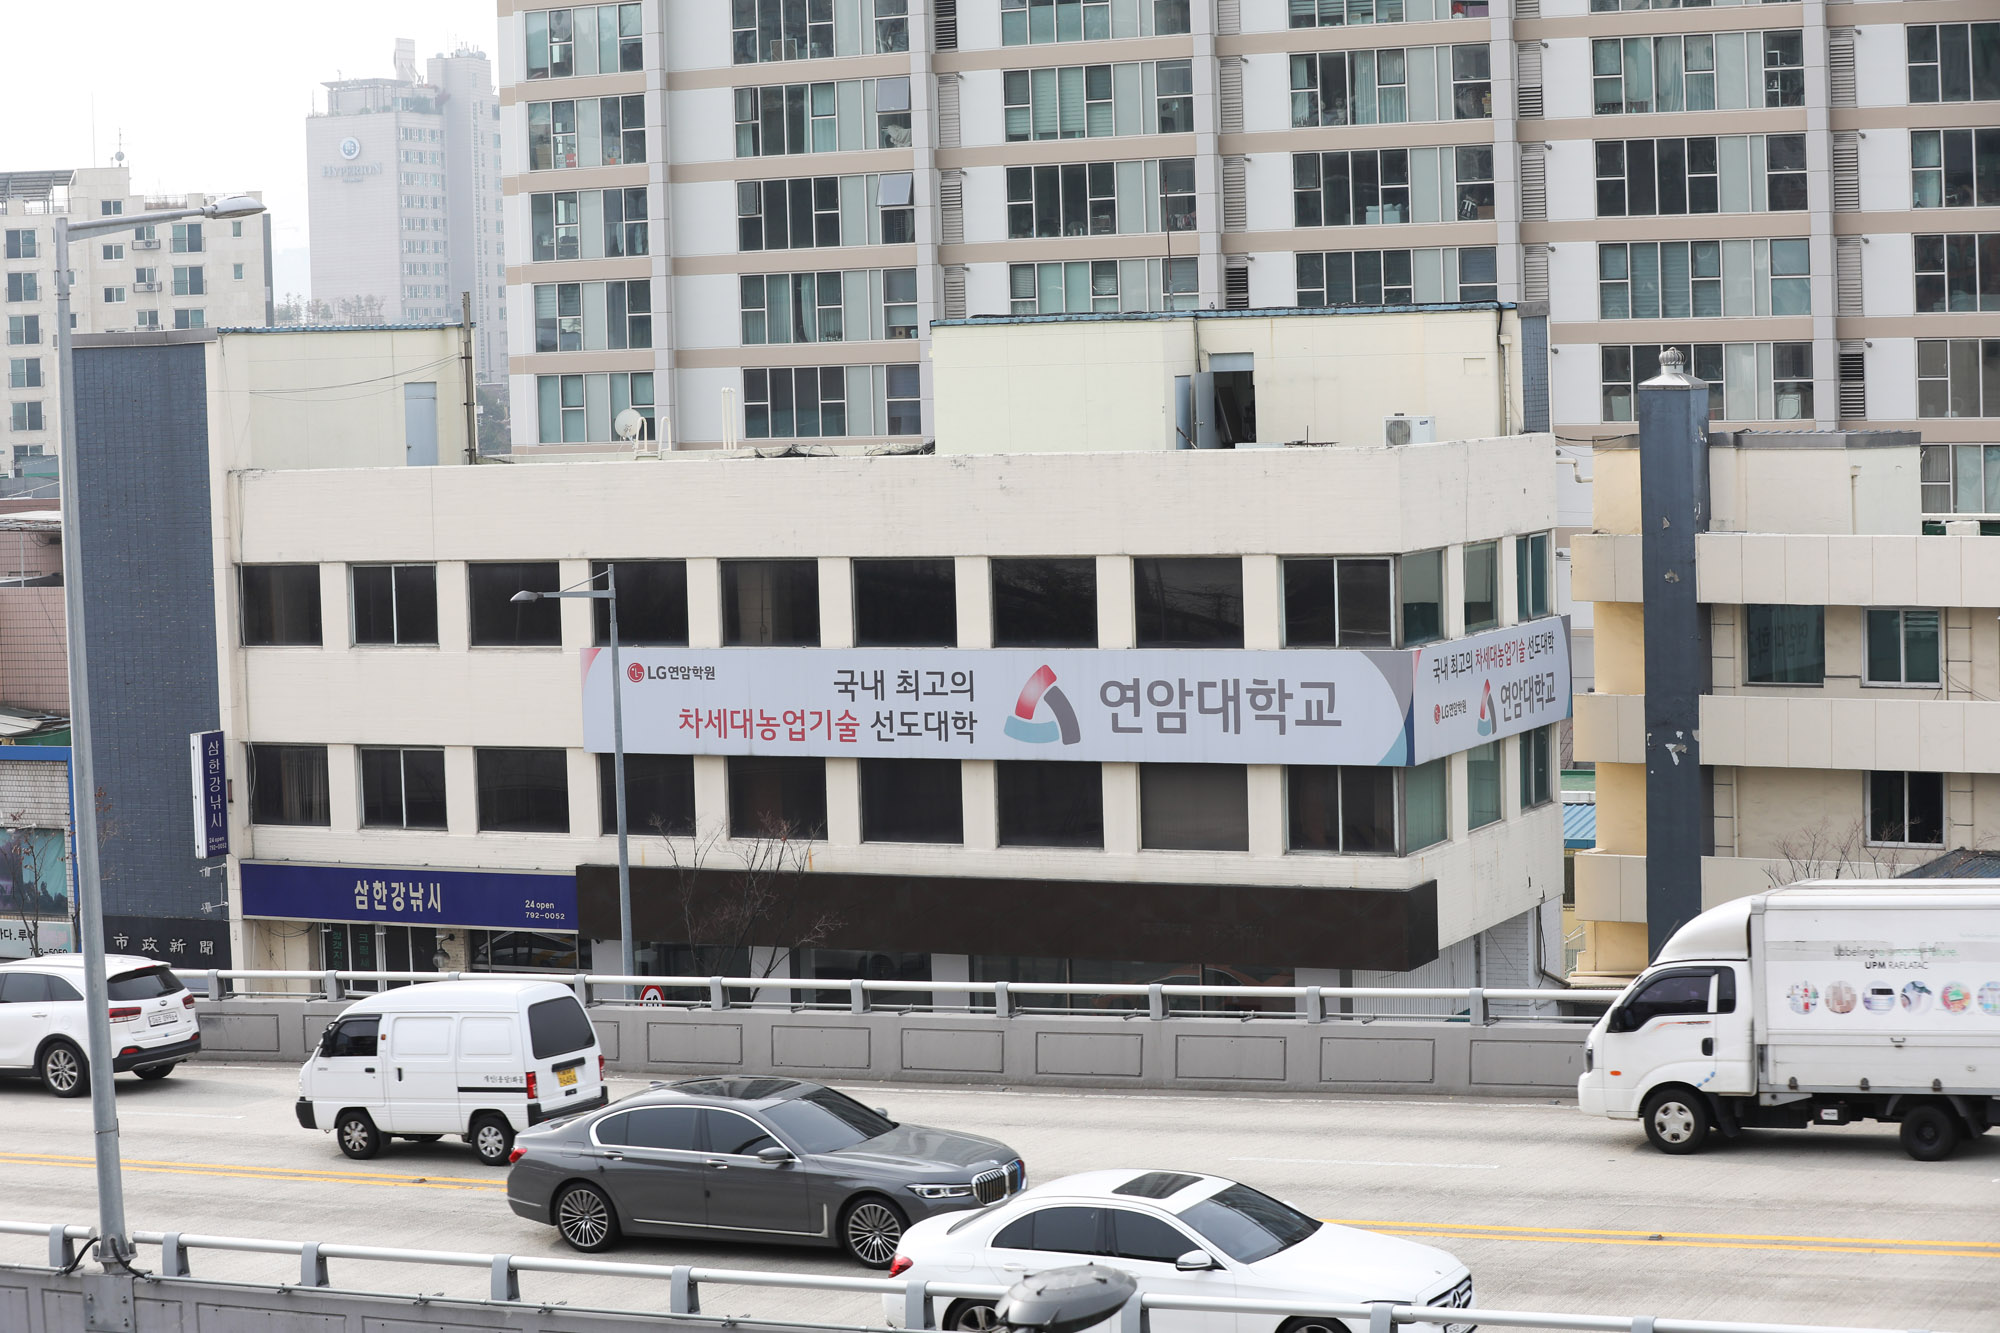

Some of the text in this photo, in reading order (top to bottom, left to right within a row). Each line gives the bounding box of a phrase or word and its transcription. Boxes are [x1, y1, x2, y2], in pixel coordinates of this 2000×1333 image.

[322, 162, 383, 177] HYPERION
[1433, 630, 1554, 684] 국내 최고의 차세대농업기술 선도대학
[647, 665, 716, 681] LG연암학원
[833, 669, 975, 702] 국내 최고의
[1100, 677, 1342, 735] 연암대학교
[1441, 699, 1467, 719] LG연암학원
[1500, 671, 1556, 722] 연암대학교
[679, 707, 978, 744] 차세대농업기술 선도대학
[208, 740, 222, 828] 삼한강낚시
[354, 879, 442, 913] 삼한강낚시
[525, 900, 555, 910] 24 open
[525, 911, 565, 920] 792-0052
[113, 932, 214, 956] 市政新聞
[1865, 961, 1886, 970] UPM
